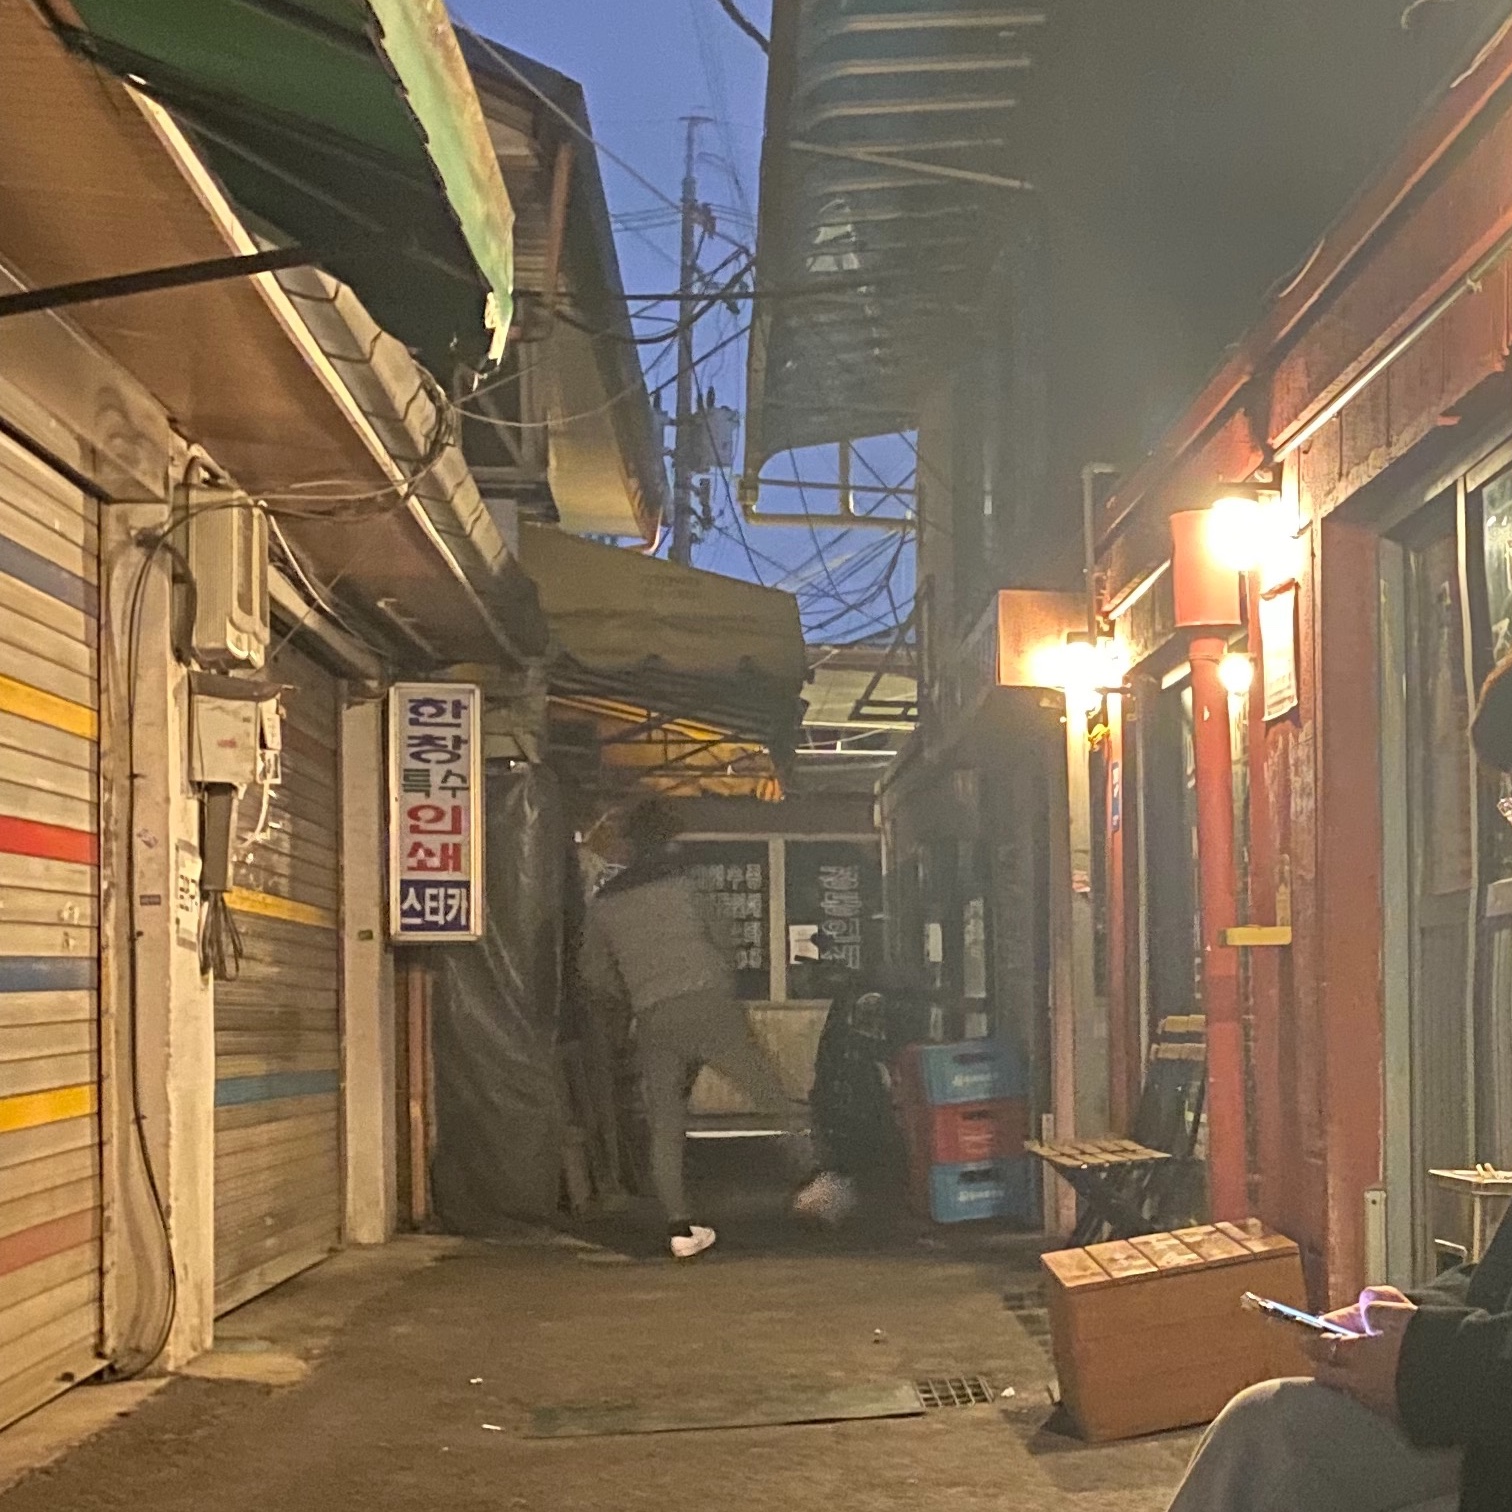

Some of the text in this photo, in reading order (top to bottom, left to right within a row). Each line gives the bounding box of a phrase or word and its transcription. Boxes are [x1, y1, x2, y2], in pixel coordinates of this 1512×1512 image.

[402, 768, 470, 798] 특수
[407, 804, 462, 872] 인쇄
[402, 887, 468, 926] 스티카
